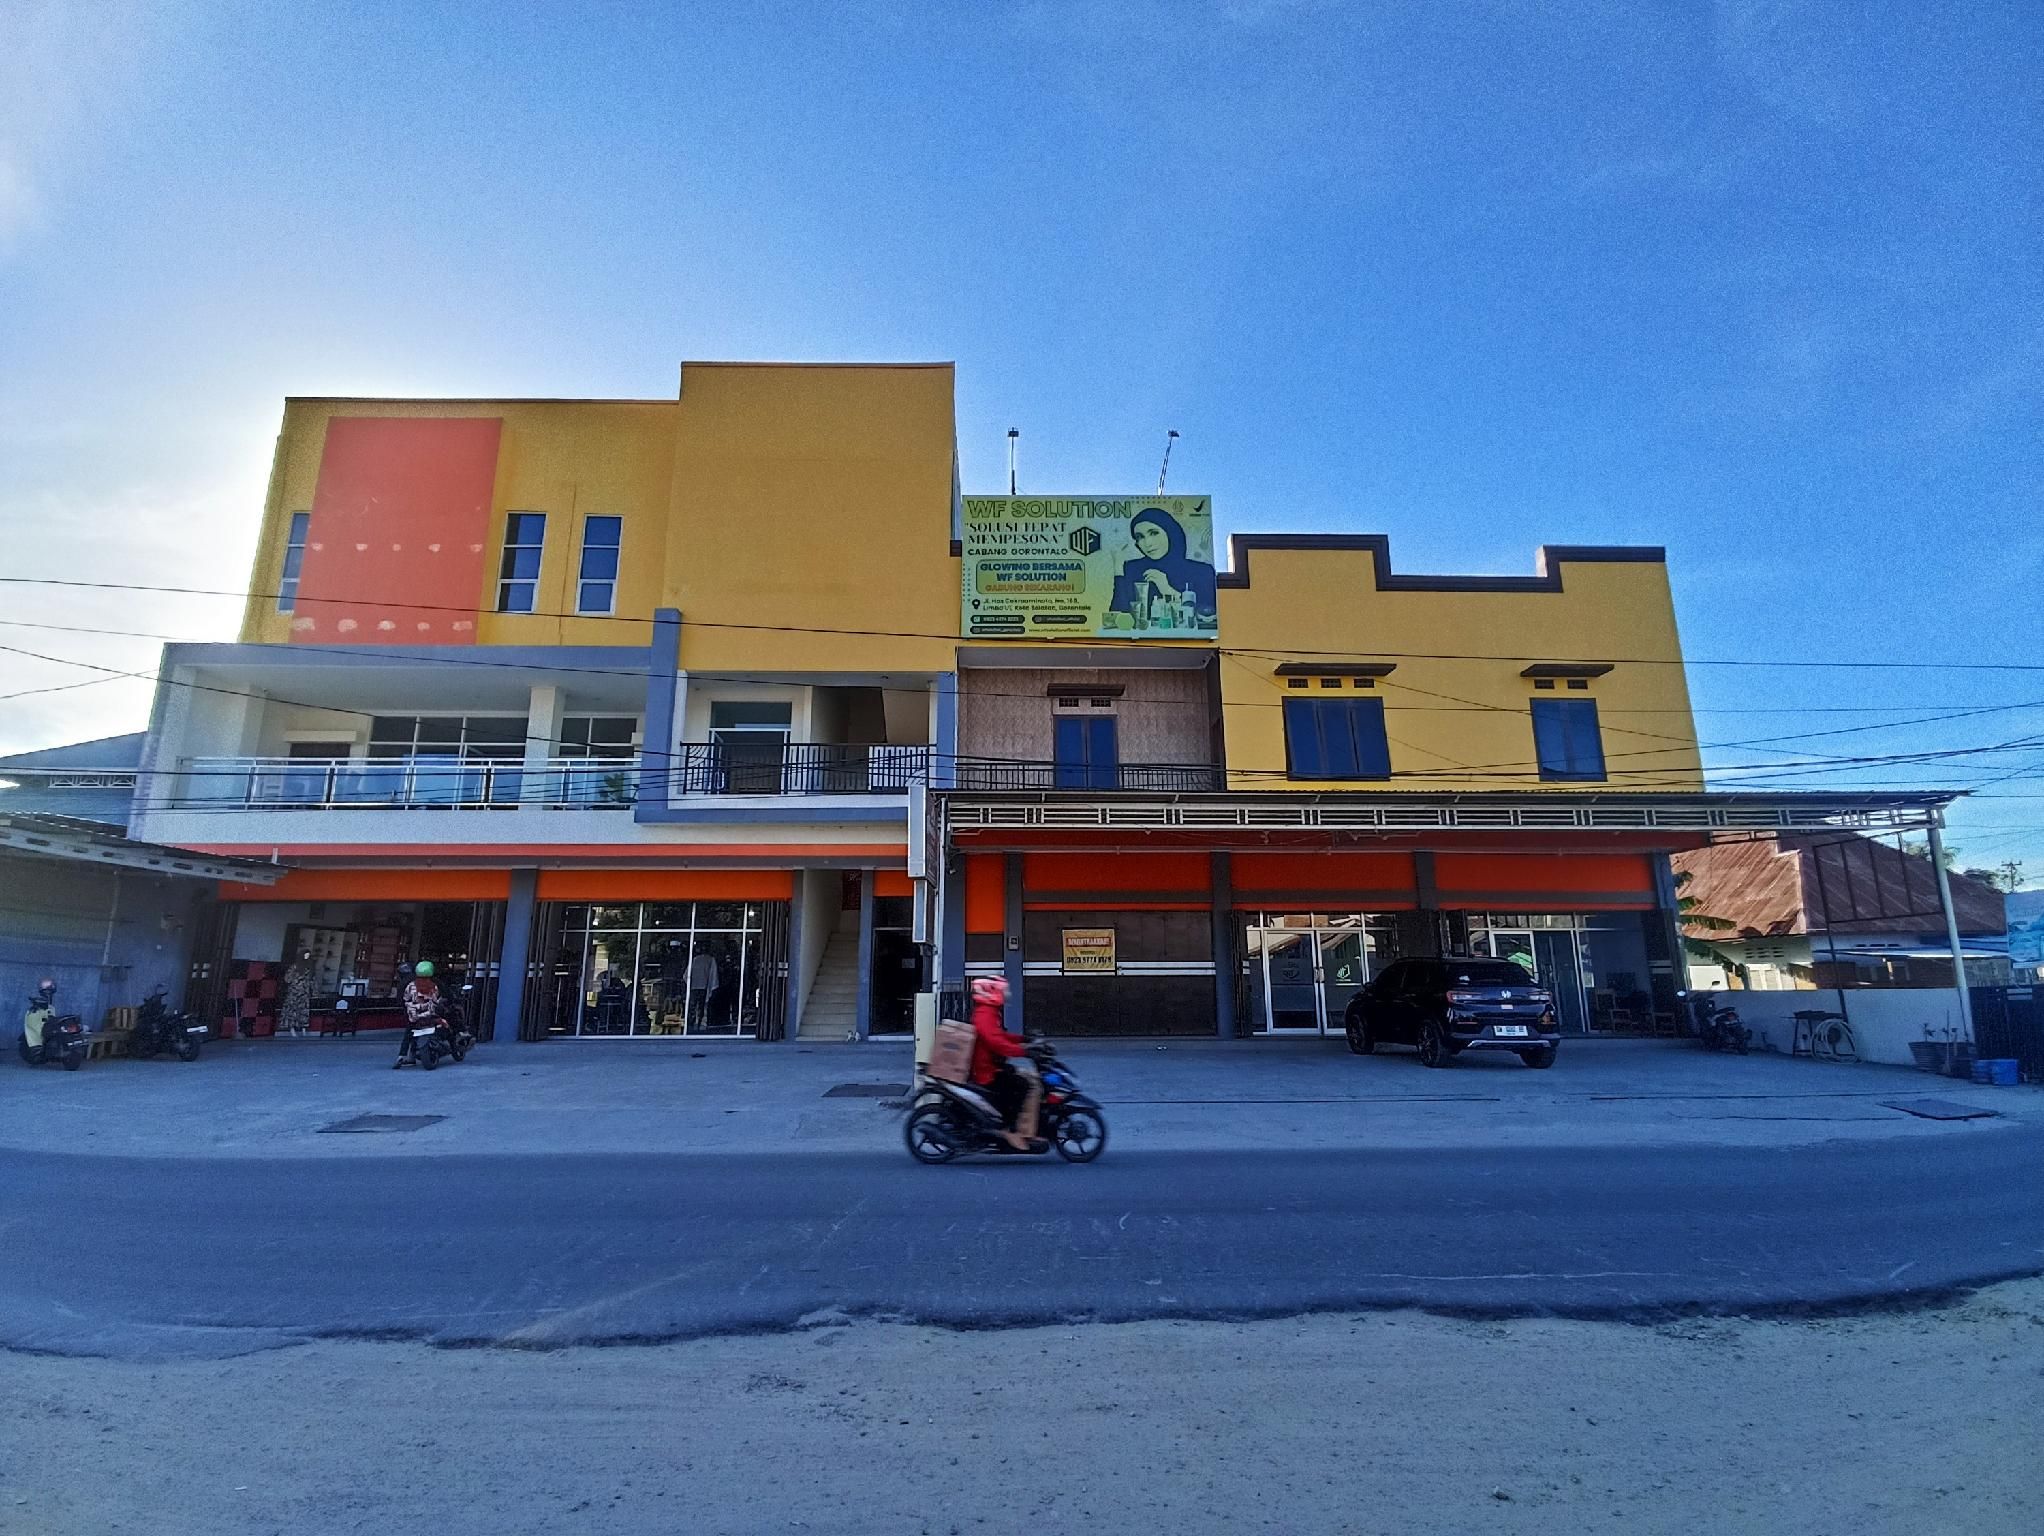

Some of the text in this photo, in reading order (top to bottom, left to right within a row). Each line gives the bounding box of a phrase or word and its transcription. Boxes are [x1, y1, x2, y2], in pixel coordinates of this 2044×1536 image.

[967, 500, 1132, 518] WF SOLUTION
[1023, 522, 1067, 533] TEPAT
[979, 562, 1083, 571] GLOWING BERSAMA
[996, 573, 1067, 581] WF SOLUTION
[985, 584, 1023, 592] GABUNG
